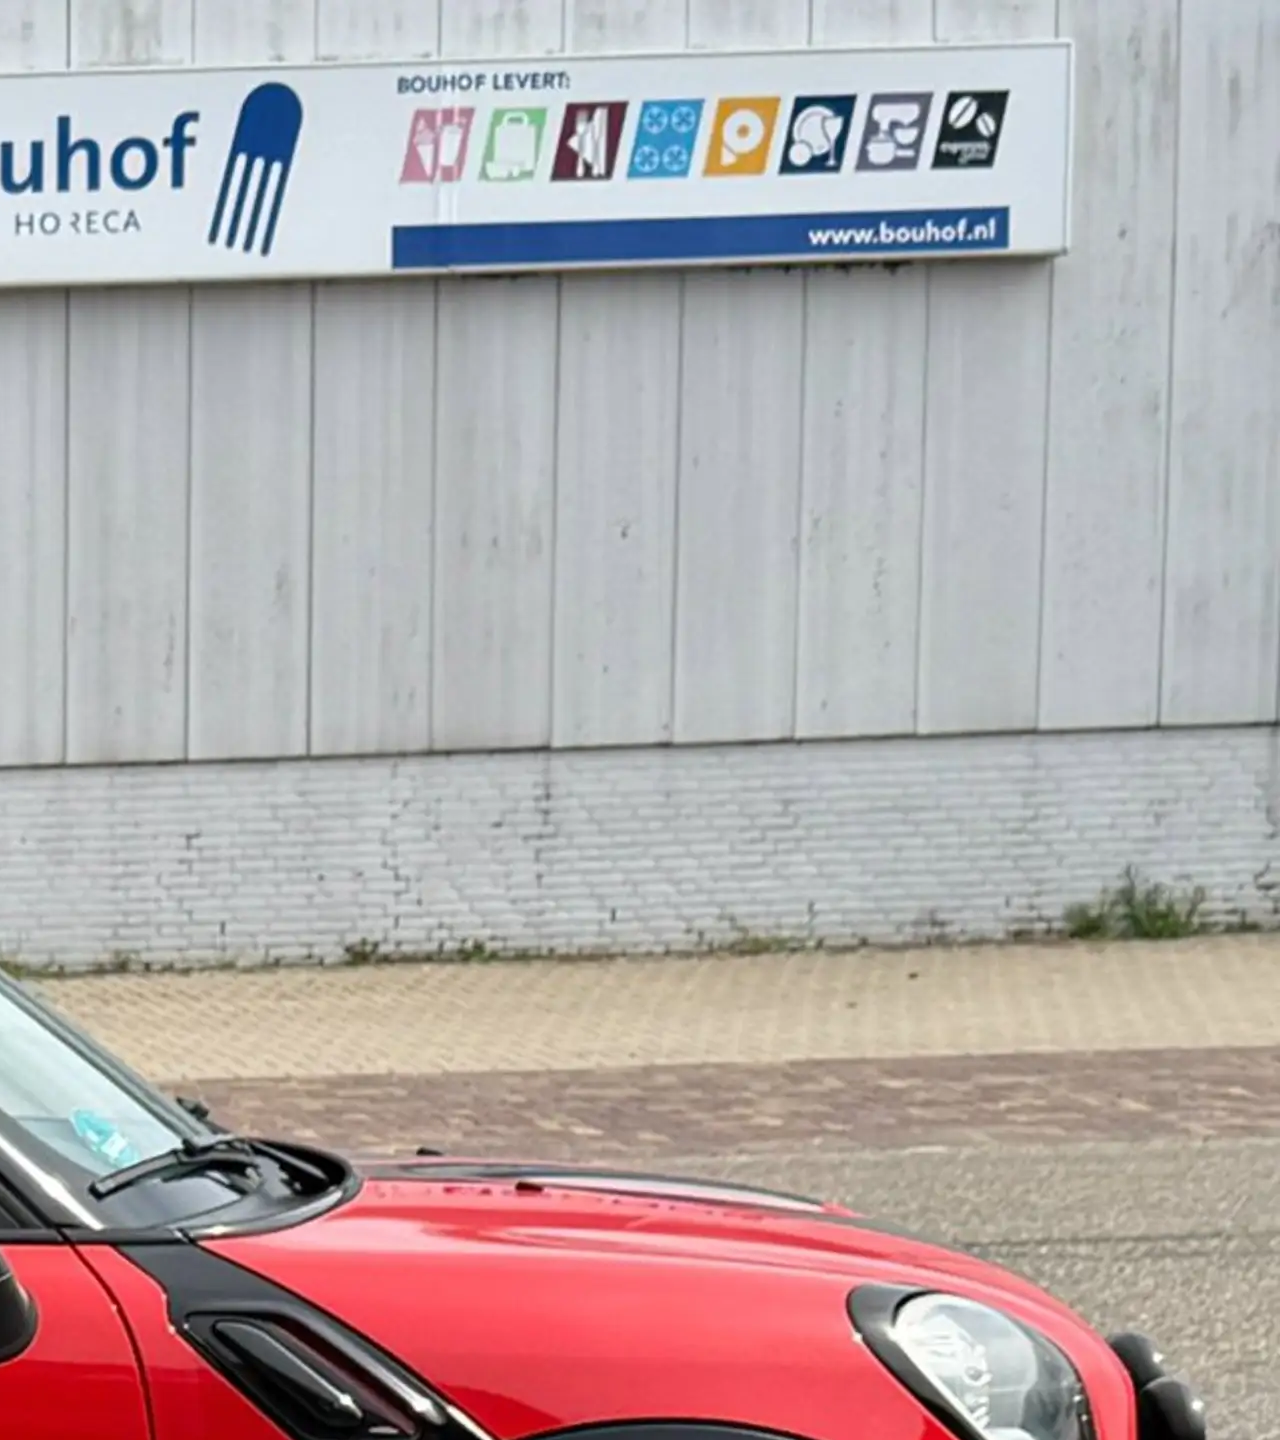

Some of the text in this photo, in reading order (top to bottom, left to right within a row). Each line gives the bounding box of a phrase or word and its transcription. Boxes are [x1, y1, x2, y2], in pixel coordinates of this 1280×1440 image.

[397, 71, 571, 94] BOUHOF LEVERT:
[14, 209, 142, 236] HORECA
[808, 217, 996, 246] www.bouhof.nl
